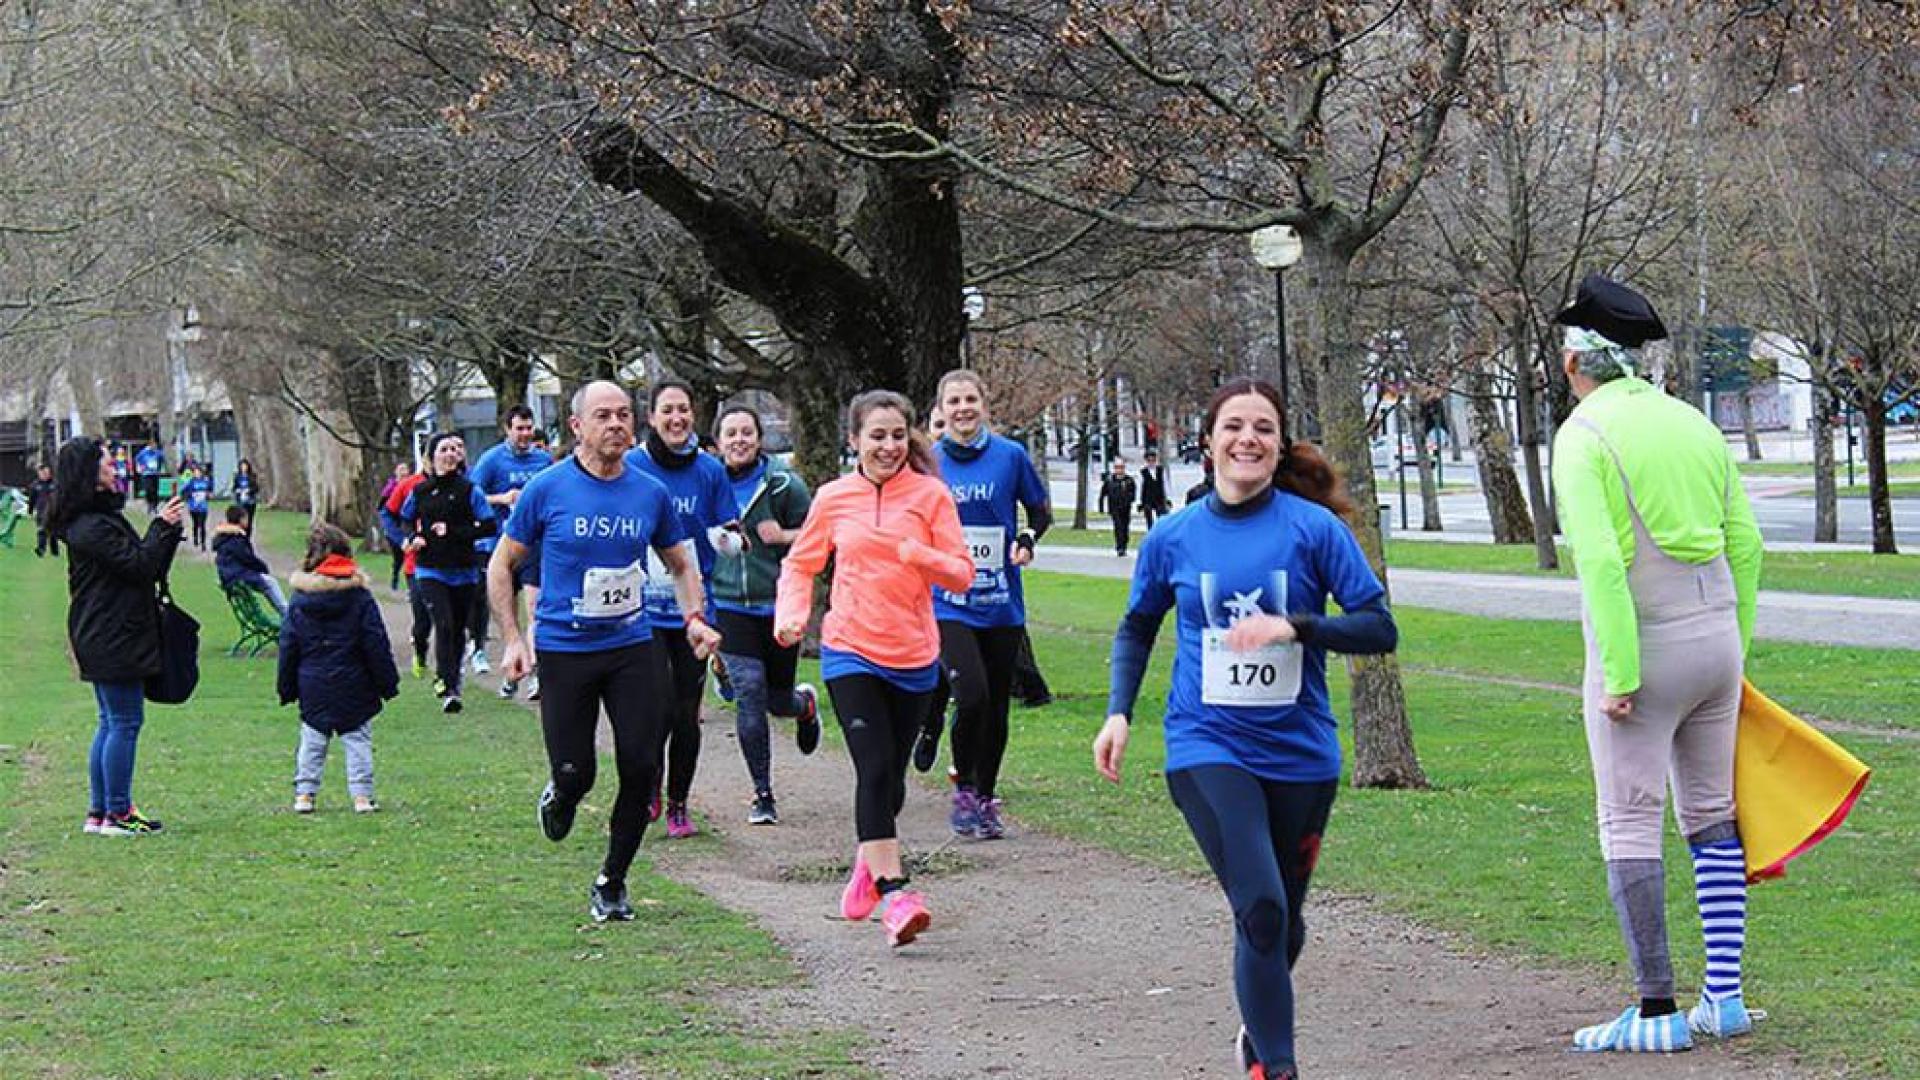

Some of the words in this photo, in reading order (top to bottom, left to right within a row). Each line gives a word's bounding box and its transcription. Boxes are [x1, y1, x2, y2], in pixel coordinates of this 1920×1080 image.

[575, 515, 642, 538] B/S/H/
[969, 544, 991, 559] 10
[602, 587, 631, 606] 124
[1228, 662, 1277, 687] 170
